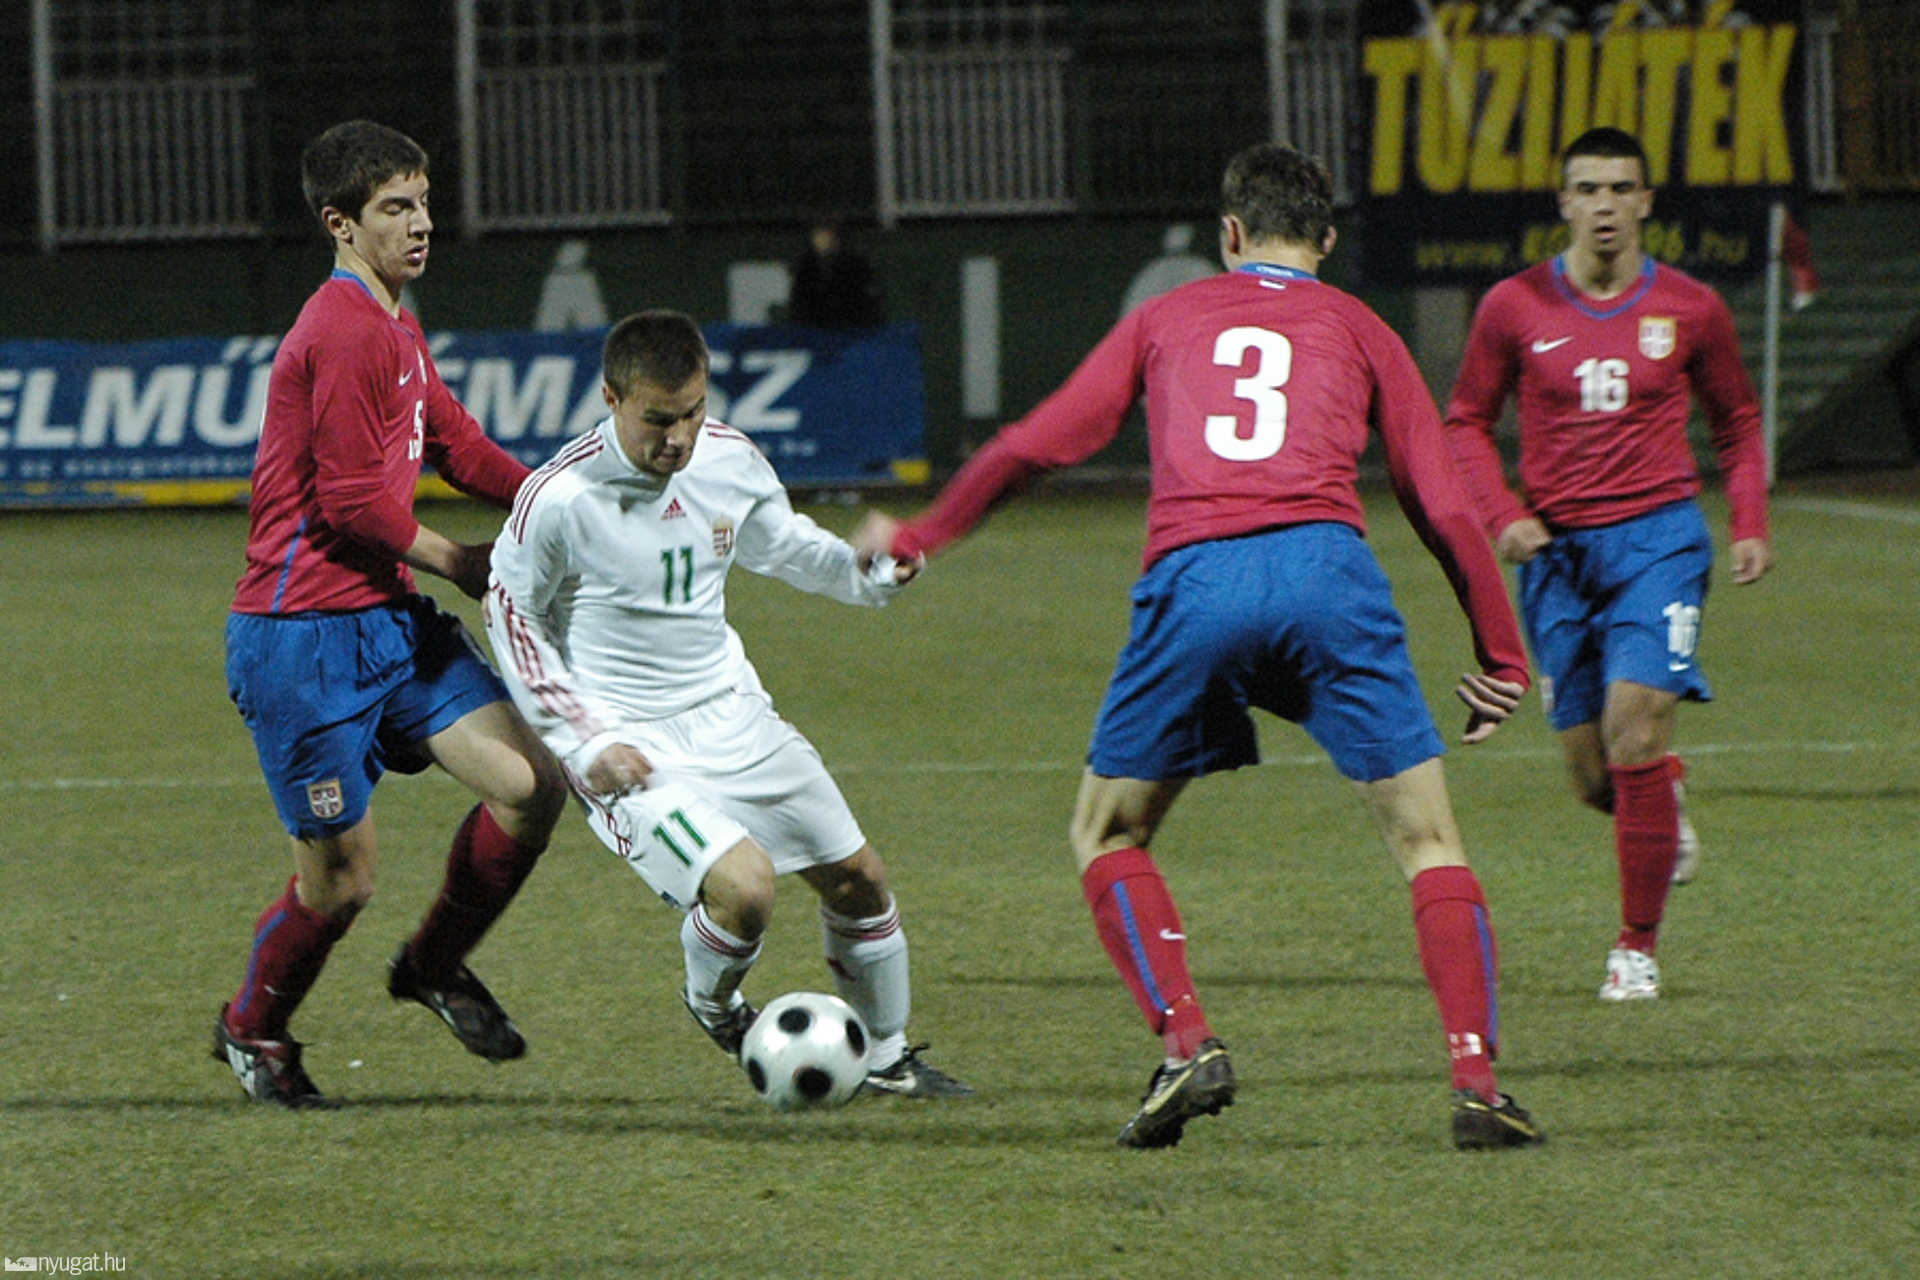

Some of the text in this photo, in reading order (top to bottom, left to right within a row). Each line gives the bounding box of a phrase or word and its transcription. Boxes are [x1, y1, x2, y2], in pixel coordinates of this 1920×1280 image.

[1204, 326, 1292, 462] 3
[1573, 357, 1630, 412] 16
[661, 547, 693, 604] 11
[652, 809, 706, 868] 11
